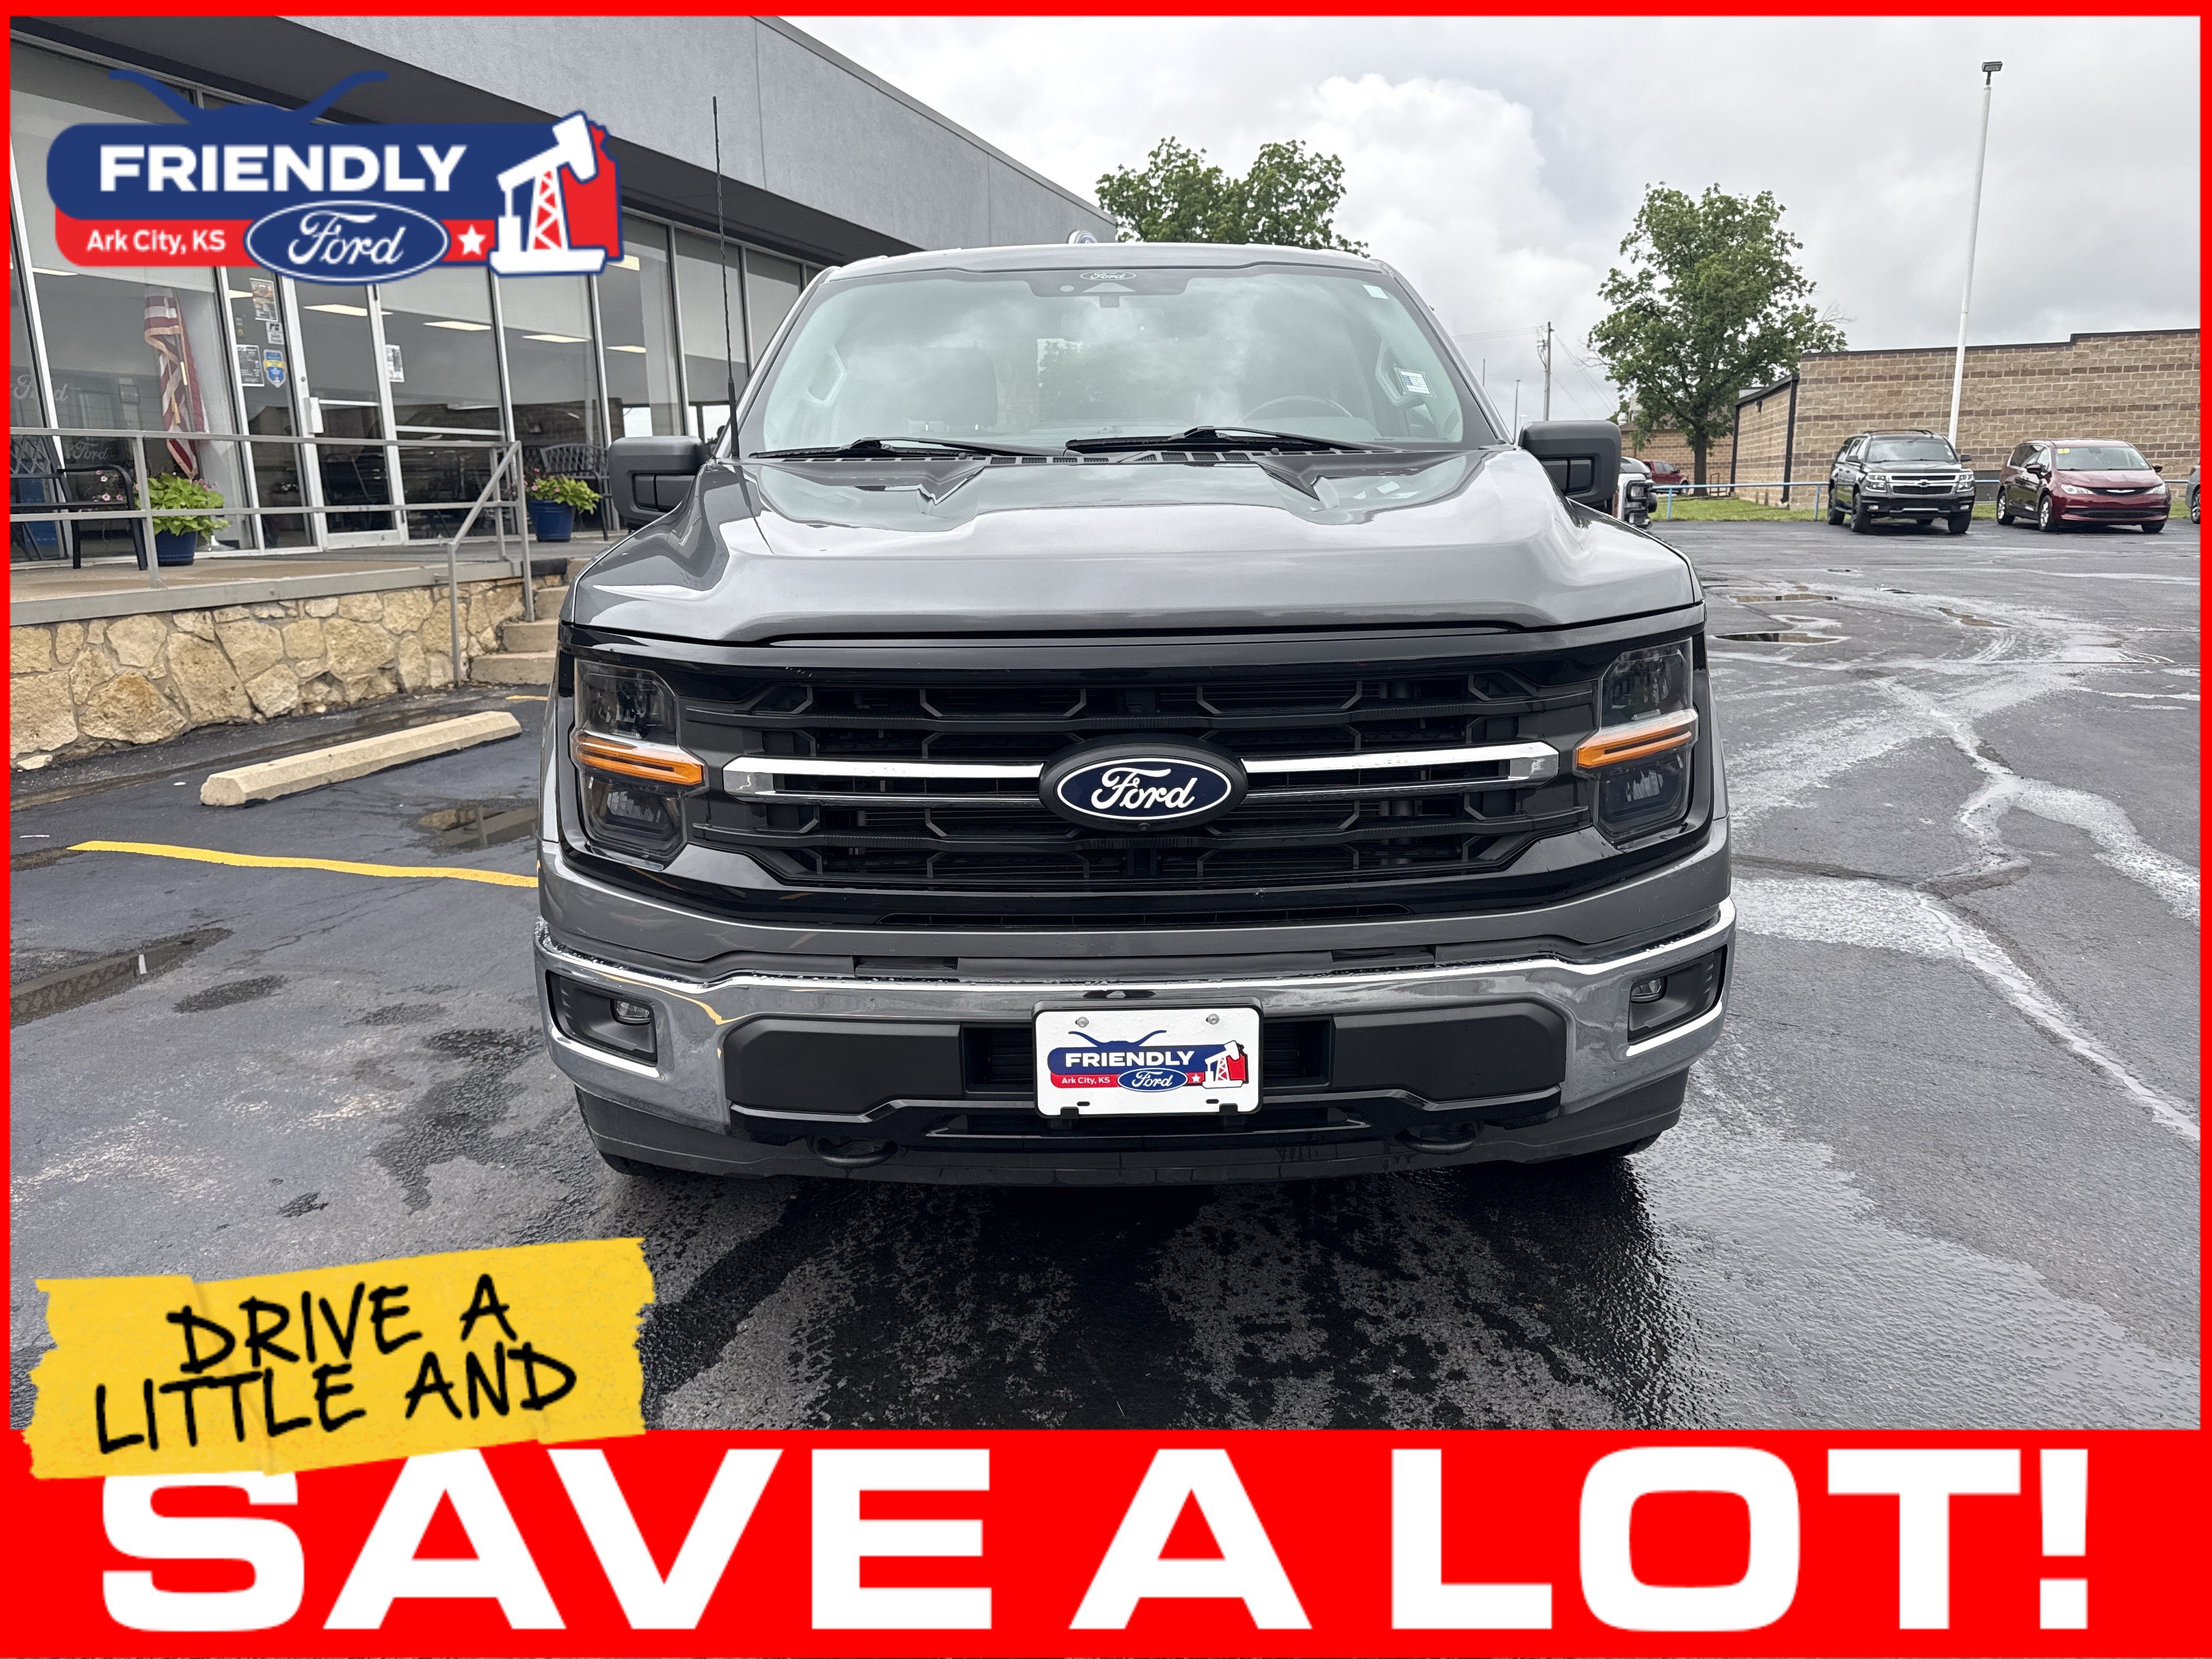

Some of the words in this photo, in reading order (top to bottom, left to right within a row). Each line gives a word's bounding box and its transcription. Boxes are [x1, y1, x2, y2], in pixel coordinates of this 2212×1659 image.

[1091, 768, 1198, 809] Ford
[1065, 1051, 1195, 1068] FRIENDLY
[1077, 1077, 1097, 1086] City,
[1131, 1071, 1173, 1088] Ford
